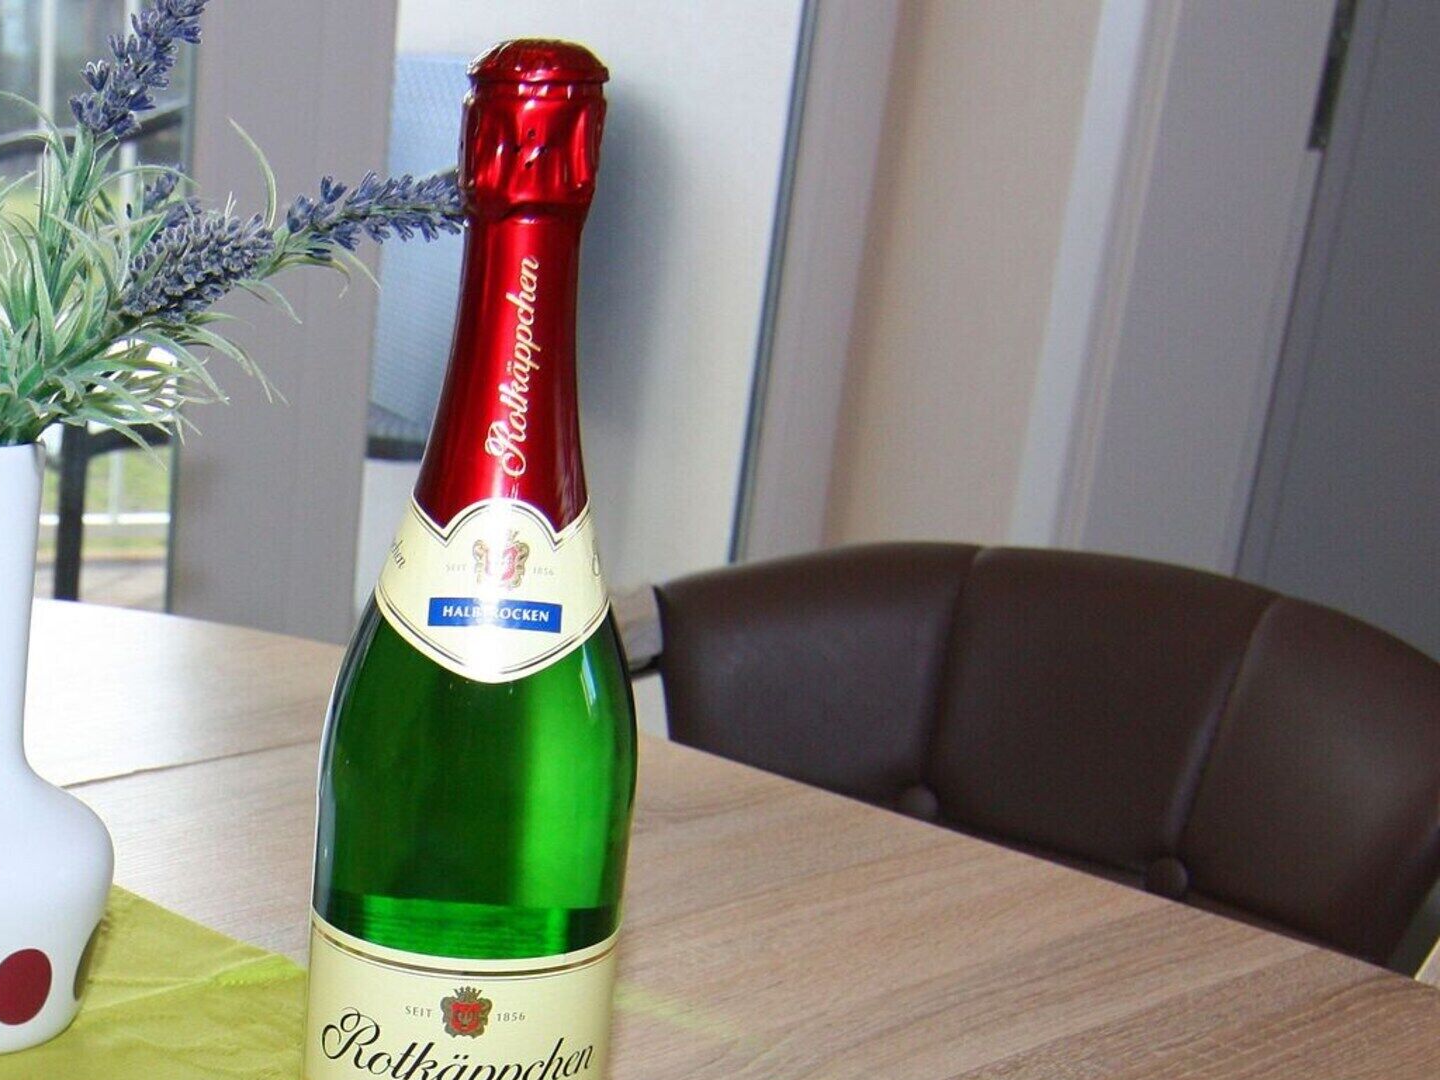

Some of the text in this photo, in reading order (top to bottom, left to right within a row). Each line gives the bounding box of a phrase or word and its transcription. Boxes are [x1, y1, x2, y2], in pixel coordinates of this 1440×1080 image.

[484, 254, 541, 479] Rotkäppchen
[404, 1005, 527, 1023] SEIT 1856
